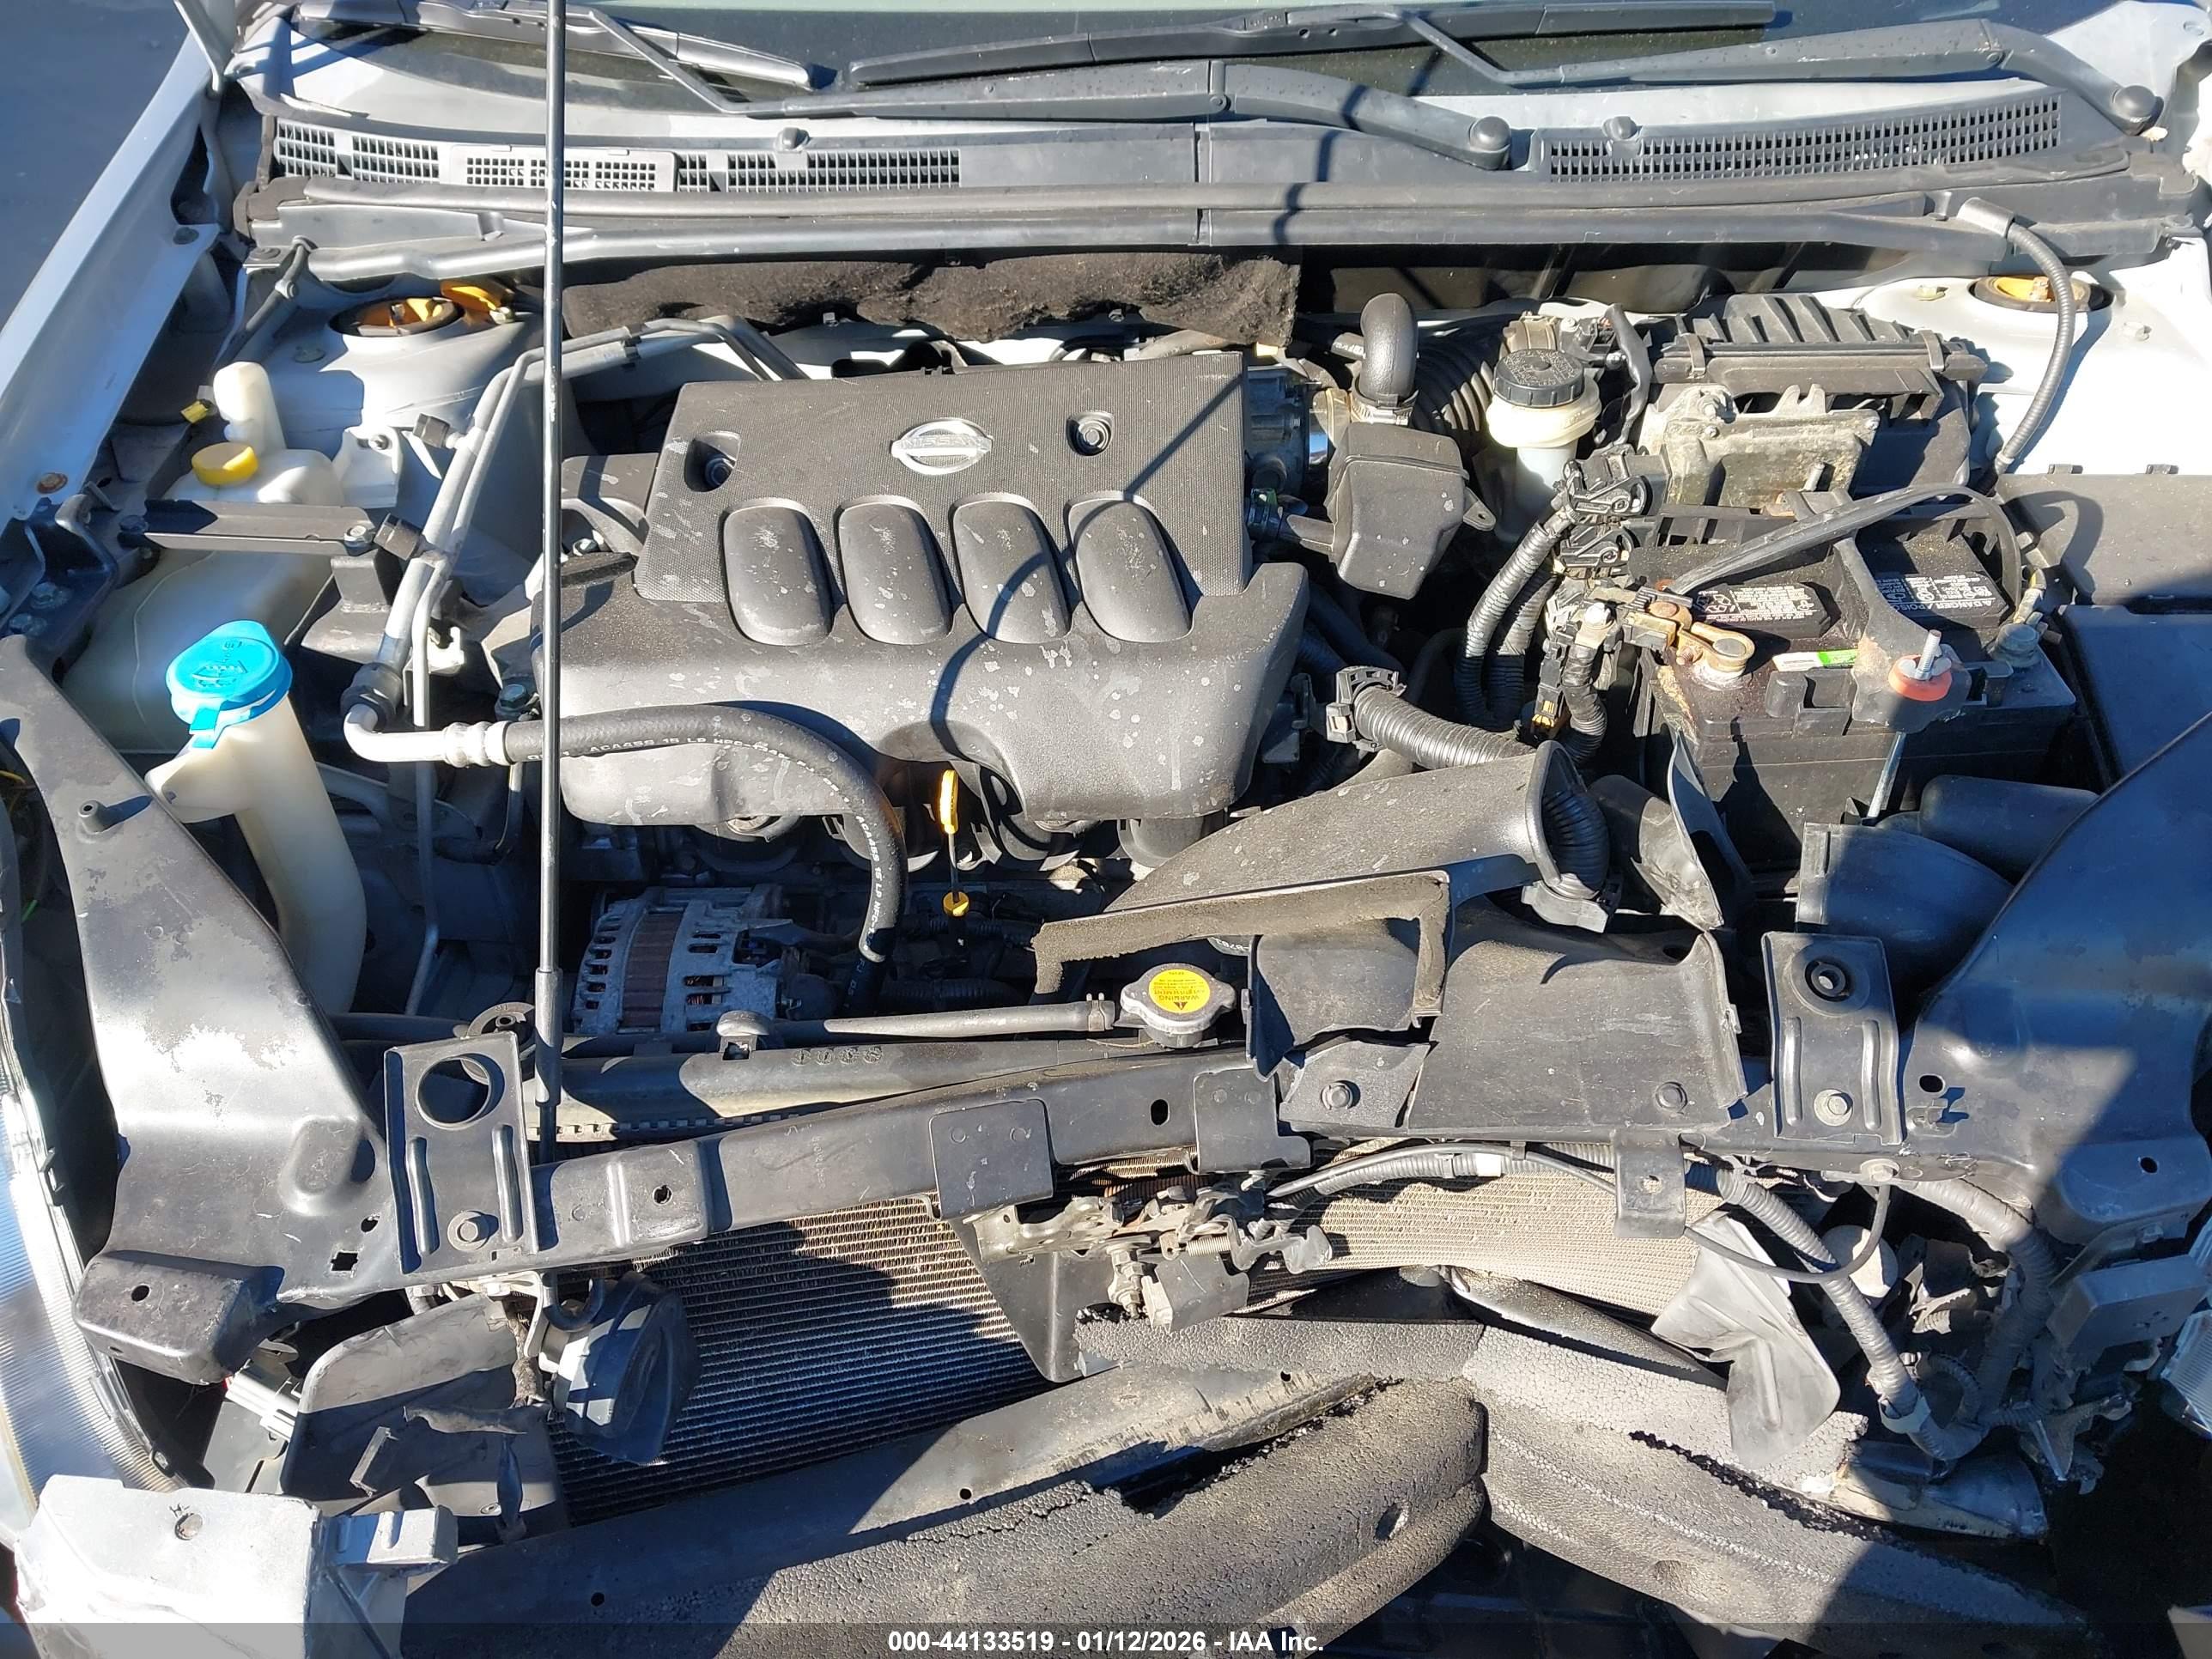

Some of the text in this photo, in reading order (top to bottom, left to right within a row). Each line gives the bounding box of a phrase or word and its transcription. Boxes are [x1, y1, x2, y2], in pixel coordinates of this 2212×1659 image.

[900, 434, 984, 449] NISSAN
[1936, 600, 1983, 610] DANGER
[874, 866, 883, 882] 15
